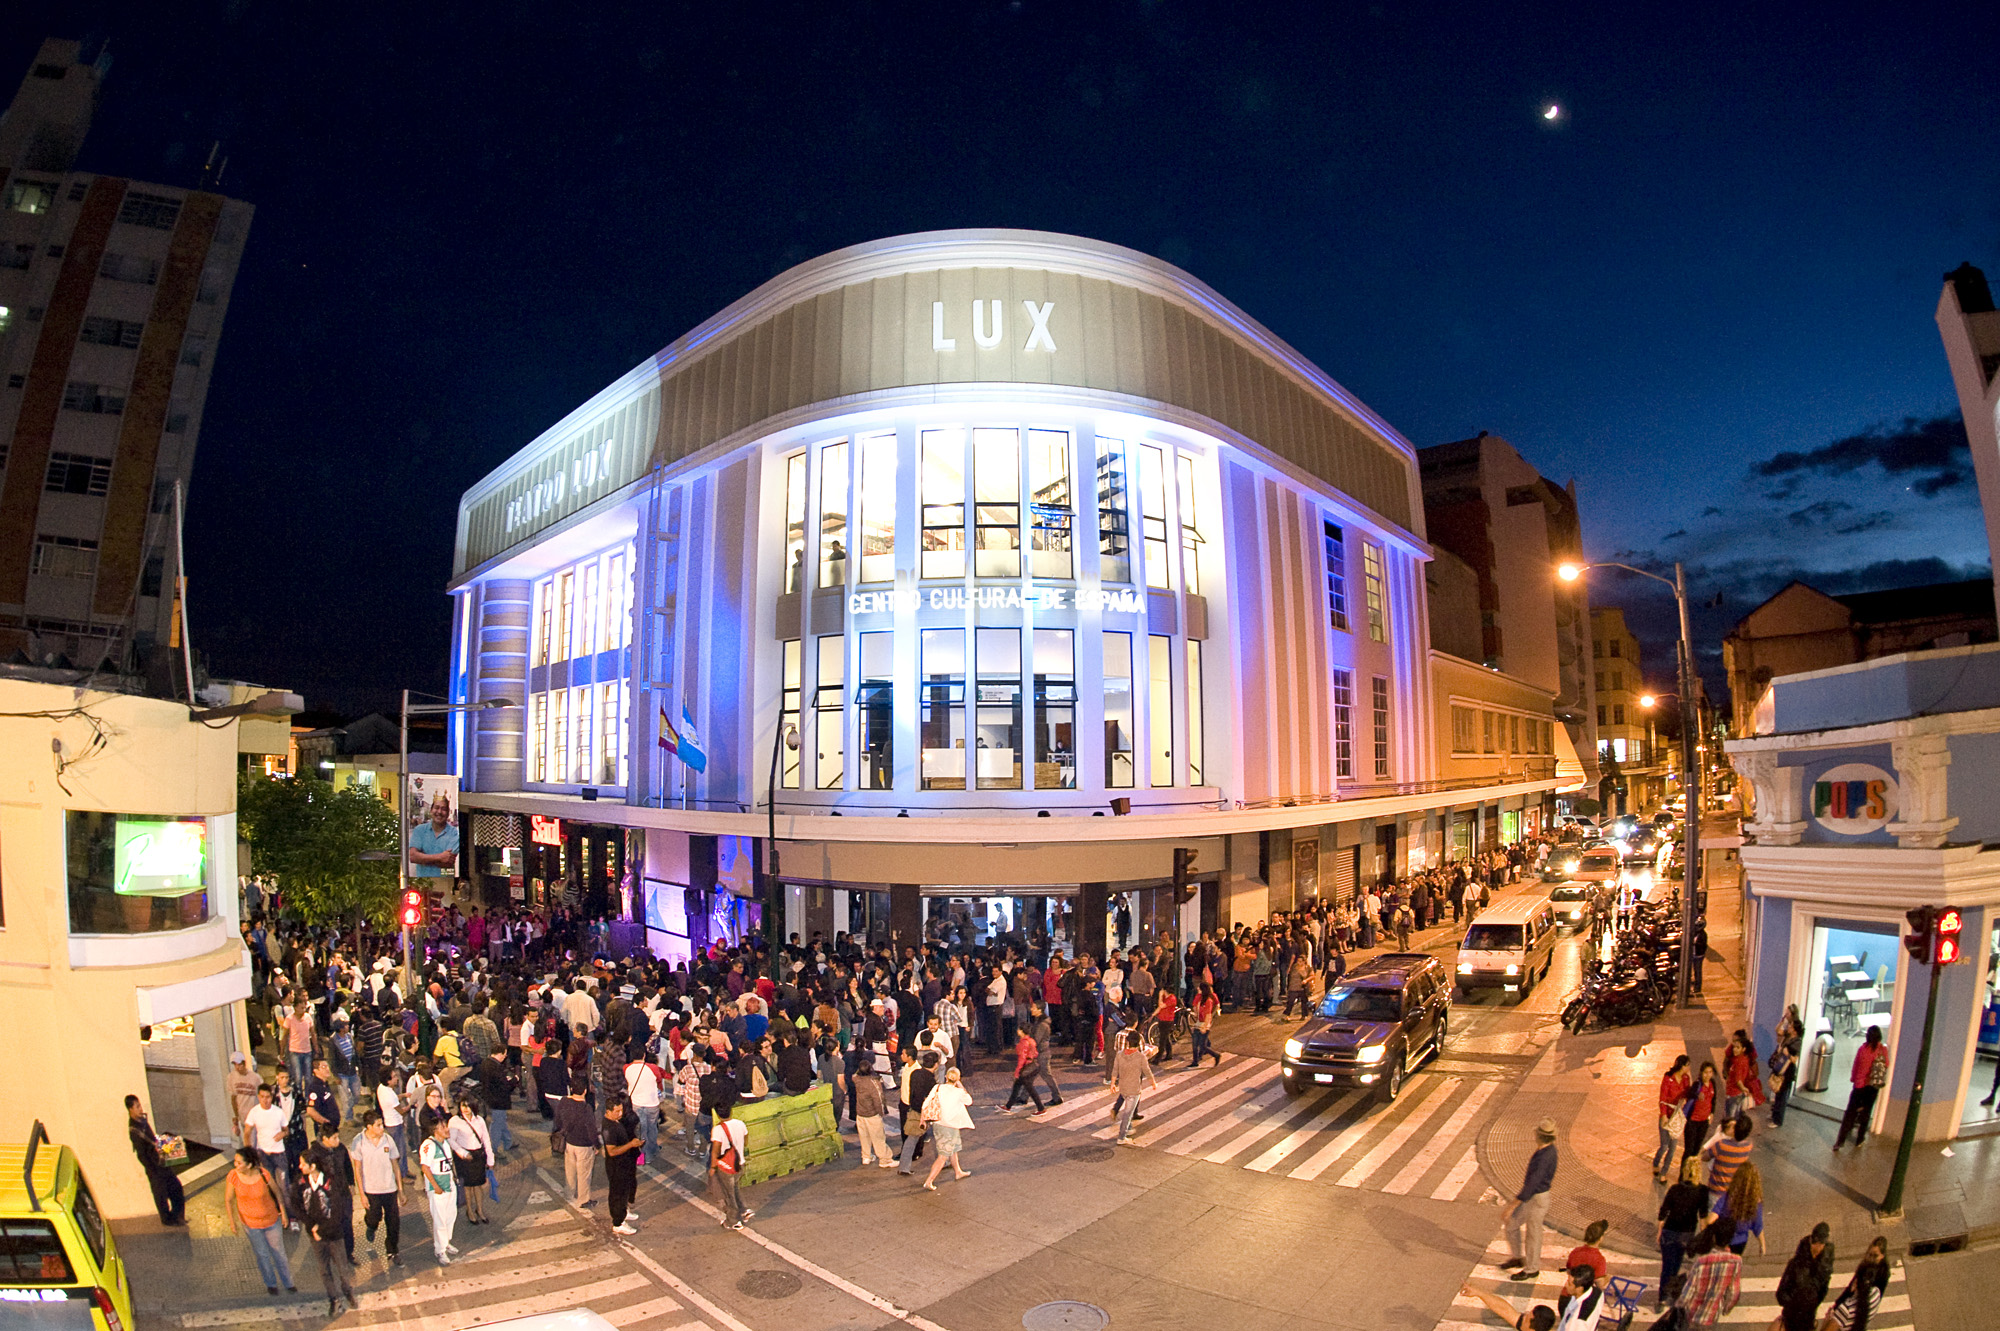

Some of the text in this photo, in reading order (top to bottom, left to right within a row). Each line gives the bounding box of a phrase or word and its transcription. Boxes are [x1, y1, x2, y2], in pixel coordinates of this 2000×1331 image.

[931, 299, 1057, 353] LUX
[506, 438, 613, 533] TEATRO LUX
[848, 586, 1147, 614] CENTO CULTURAL DE ESPAÑA
[1814, 779, 1887, 820] POPS
